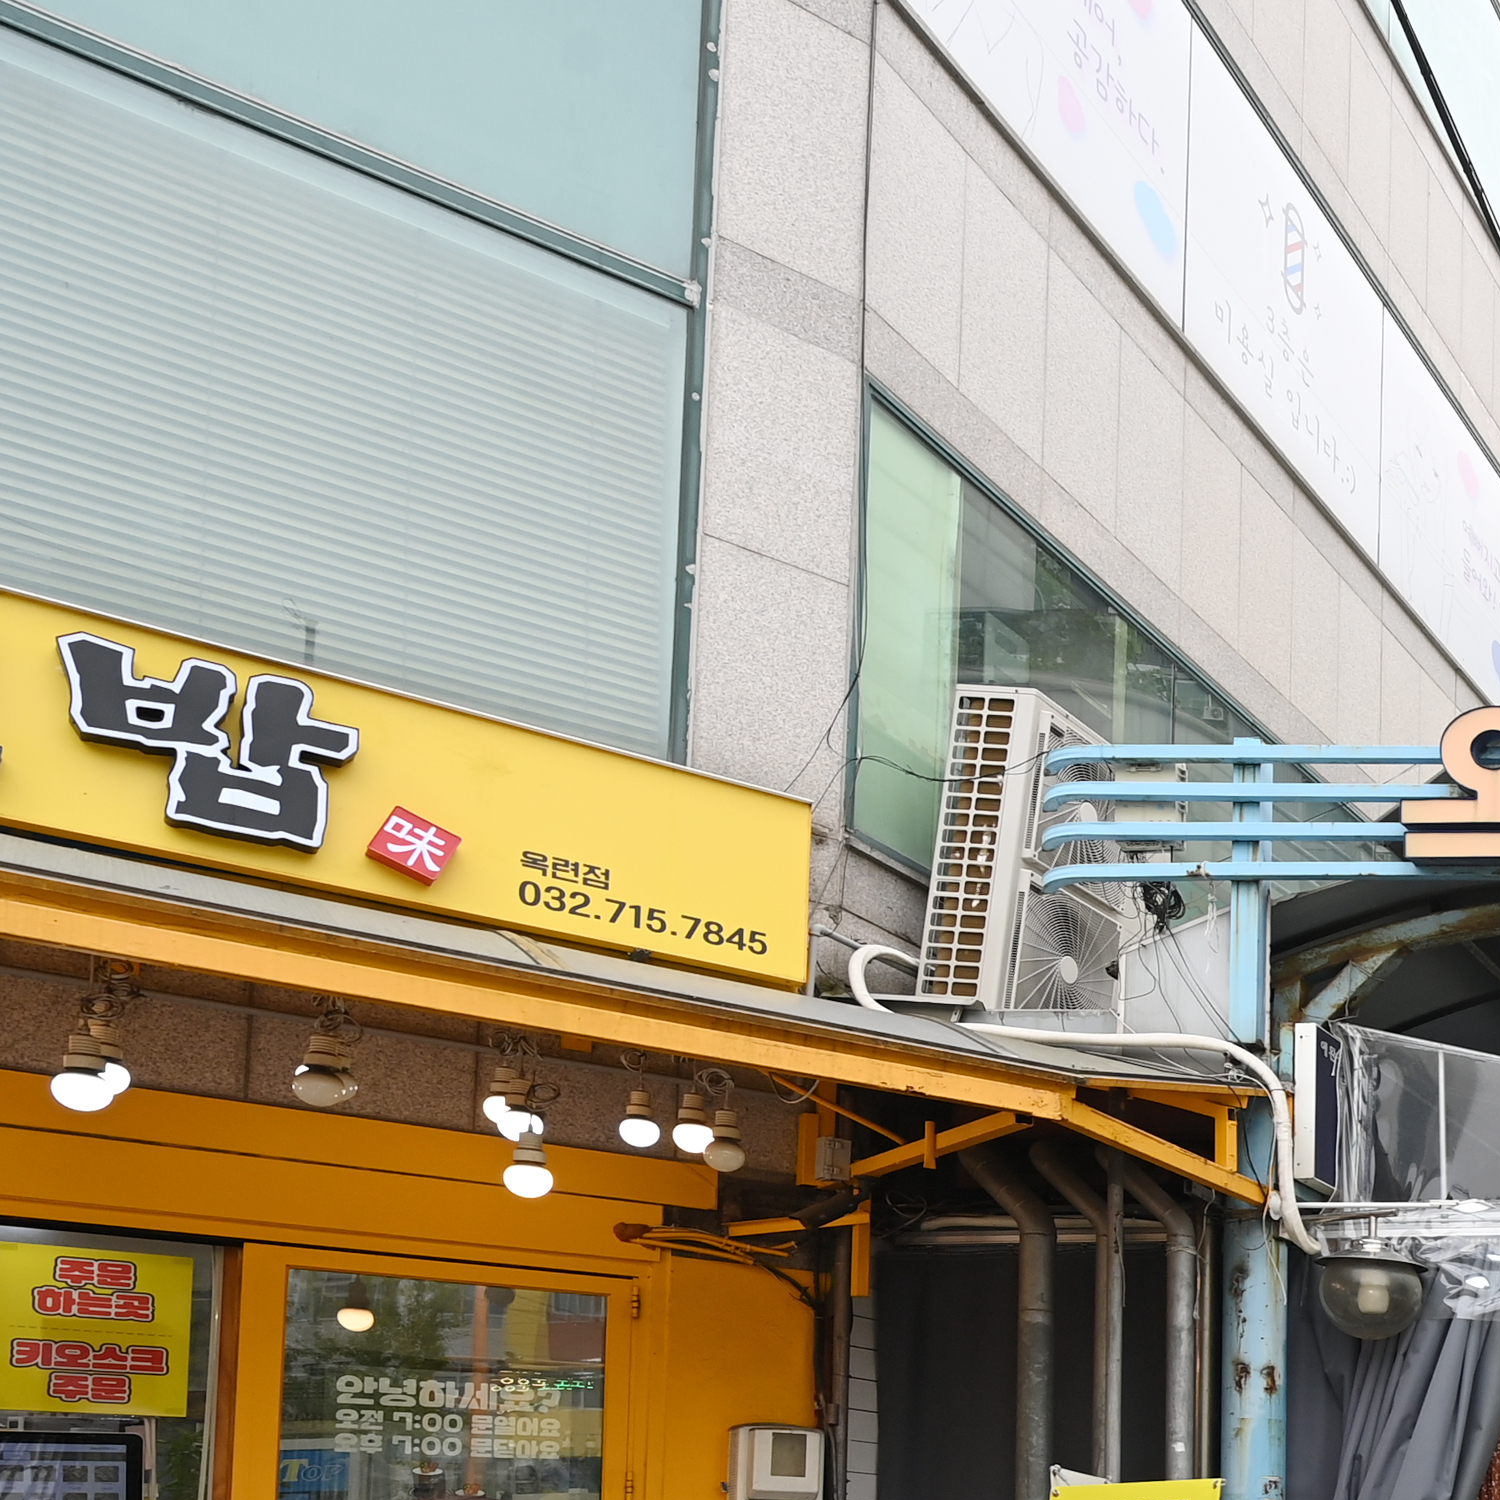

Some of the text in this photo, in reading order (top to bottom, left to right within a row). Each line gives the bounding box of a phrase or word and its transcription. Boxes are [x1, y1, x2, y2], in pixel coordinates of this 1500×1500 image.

[1067, 18, 1165, 175] 공감하다.
[1214, 299, 1273, 399] 미용실
[519, 850, 612, 892] 옥련점
[518, 878, 769, 957] 032.715.7845
[55, 1257, 137, 1291] 주문
[33, 1286, 155, 1323] 하는곳
[11, 1338, 169, 1375] 키오스크
[48, 1371, 131, 1404] 주문
[336, 1374, 561, 1414] 안녕하세요?
[335, 1409, 561, 1438] 오전 7:00 문열어요
[334, 1433, 560, 1460] 오후 7:00 문닫아요
